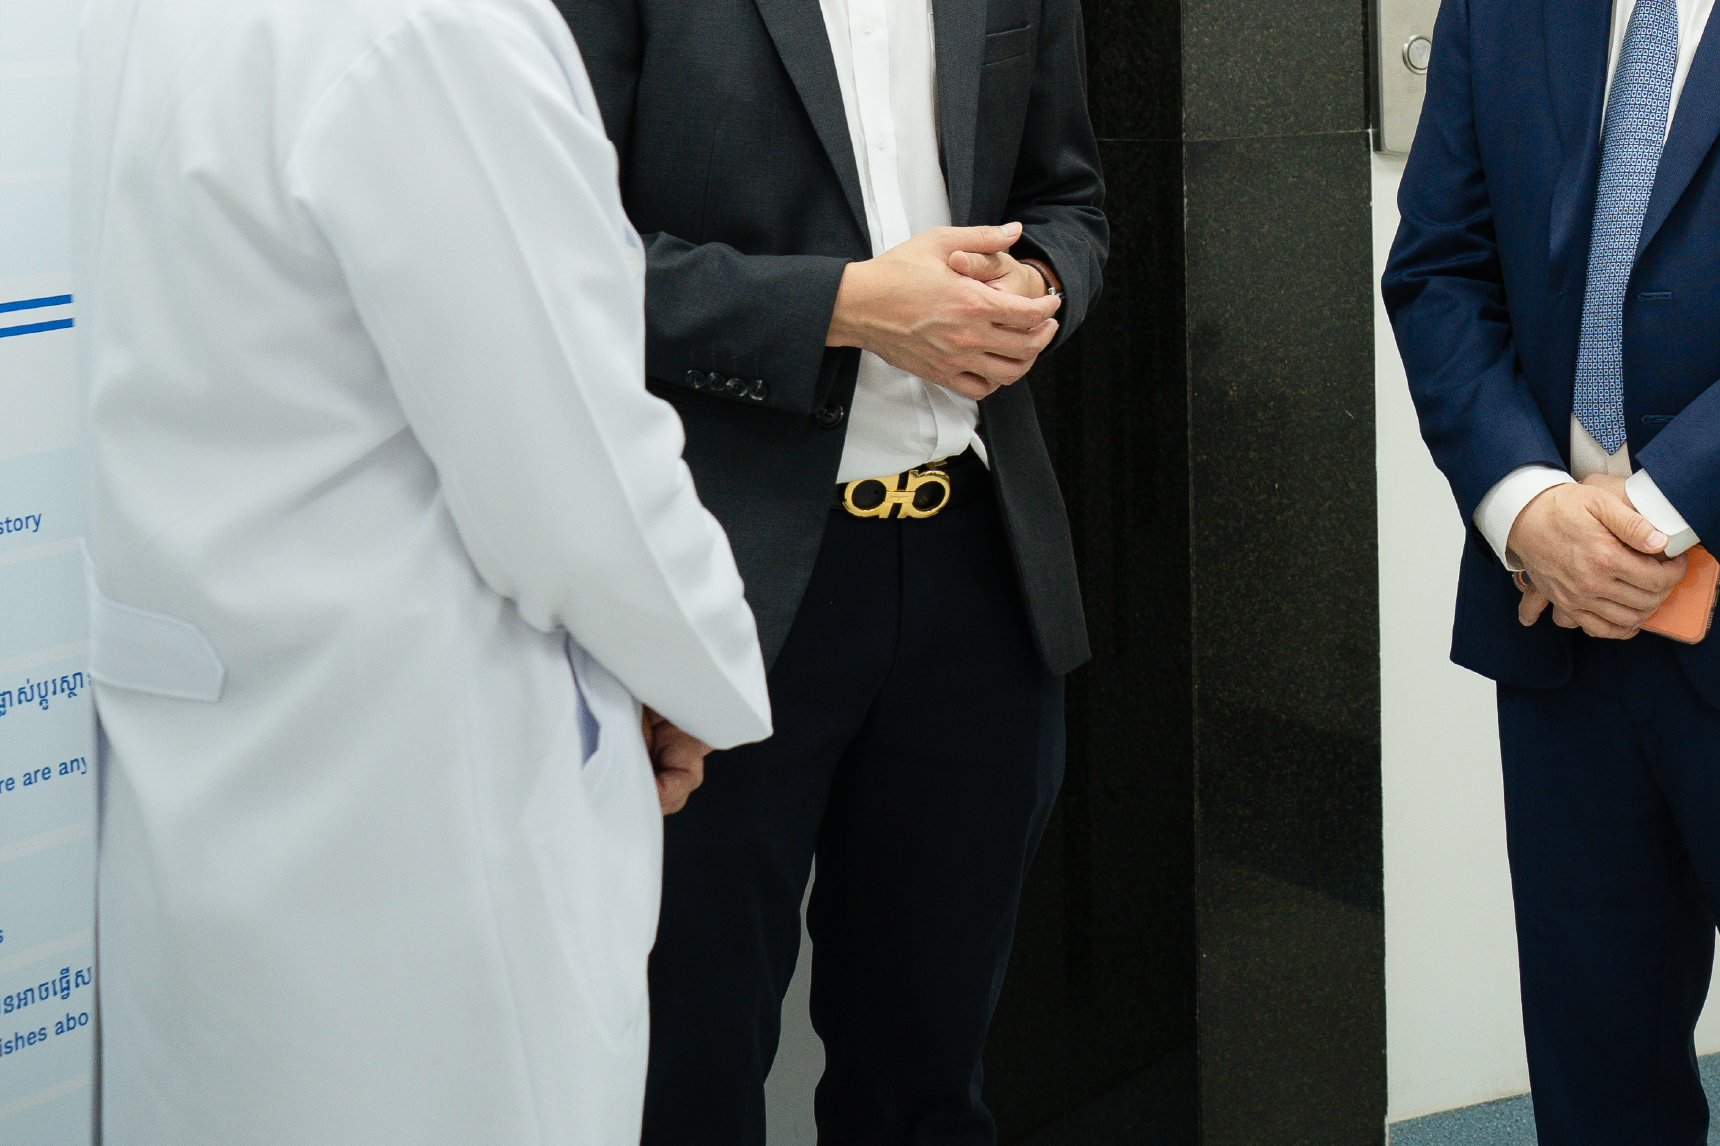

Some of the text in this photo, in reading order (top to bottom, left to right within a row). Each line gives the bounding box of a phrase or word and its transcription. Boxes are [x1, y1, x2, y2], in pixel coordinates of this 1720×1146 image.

[23, 765, 52, 786] are
[58, 756, 87, 776] any
[55, 1012, 89, 1035] abo
